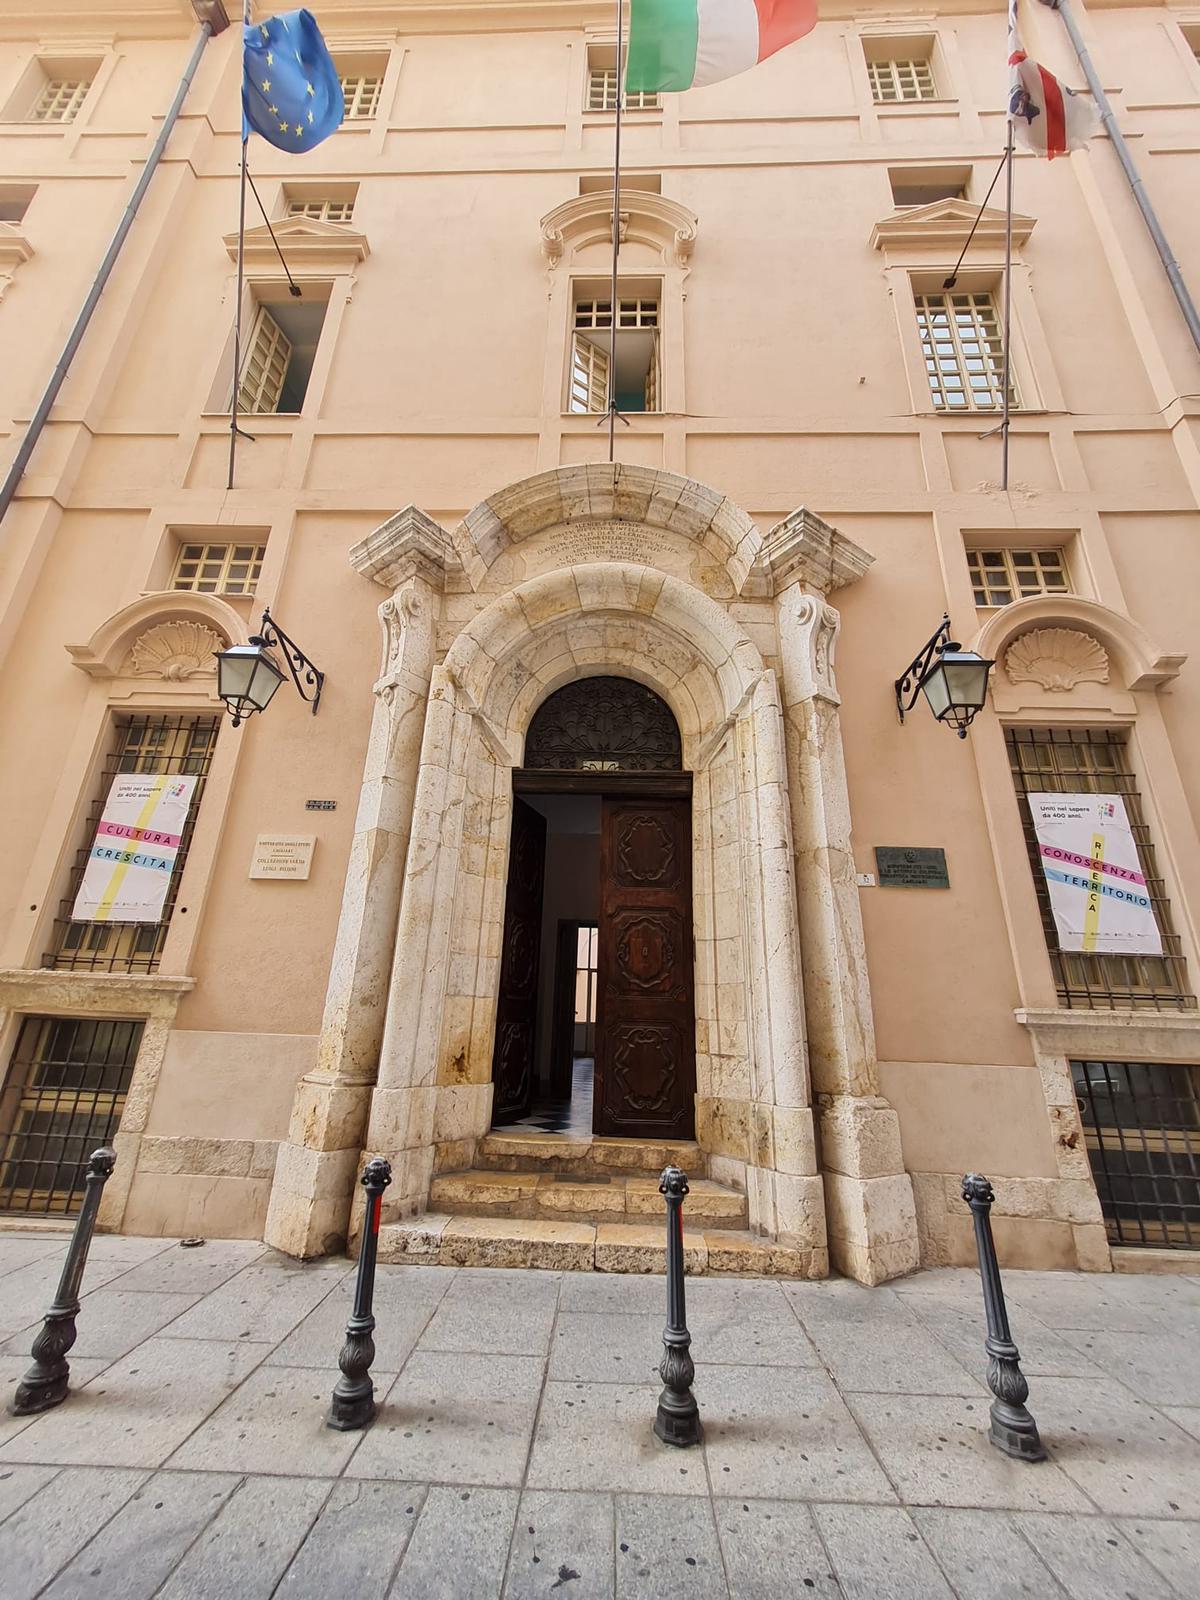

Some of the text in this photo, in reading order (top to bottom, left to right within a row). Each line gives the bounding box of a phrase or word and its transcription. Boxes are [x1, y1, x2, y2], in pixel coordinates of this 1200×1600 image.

[106, 825, 171, 845] CULTURA
[96, 848, 167, 869] CRESCITA
[1044, 847, 1136, 881] CONOSCENZA
[1063, 874, 1148, 906] TERRITORIO
[1088, 841, 1102, 913] RICERCA
